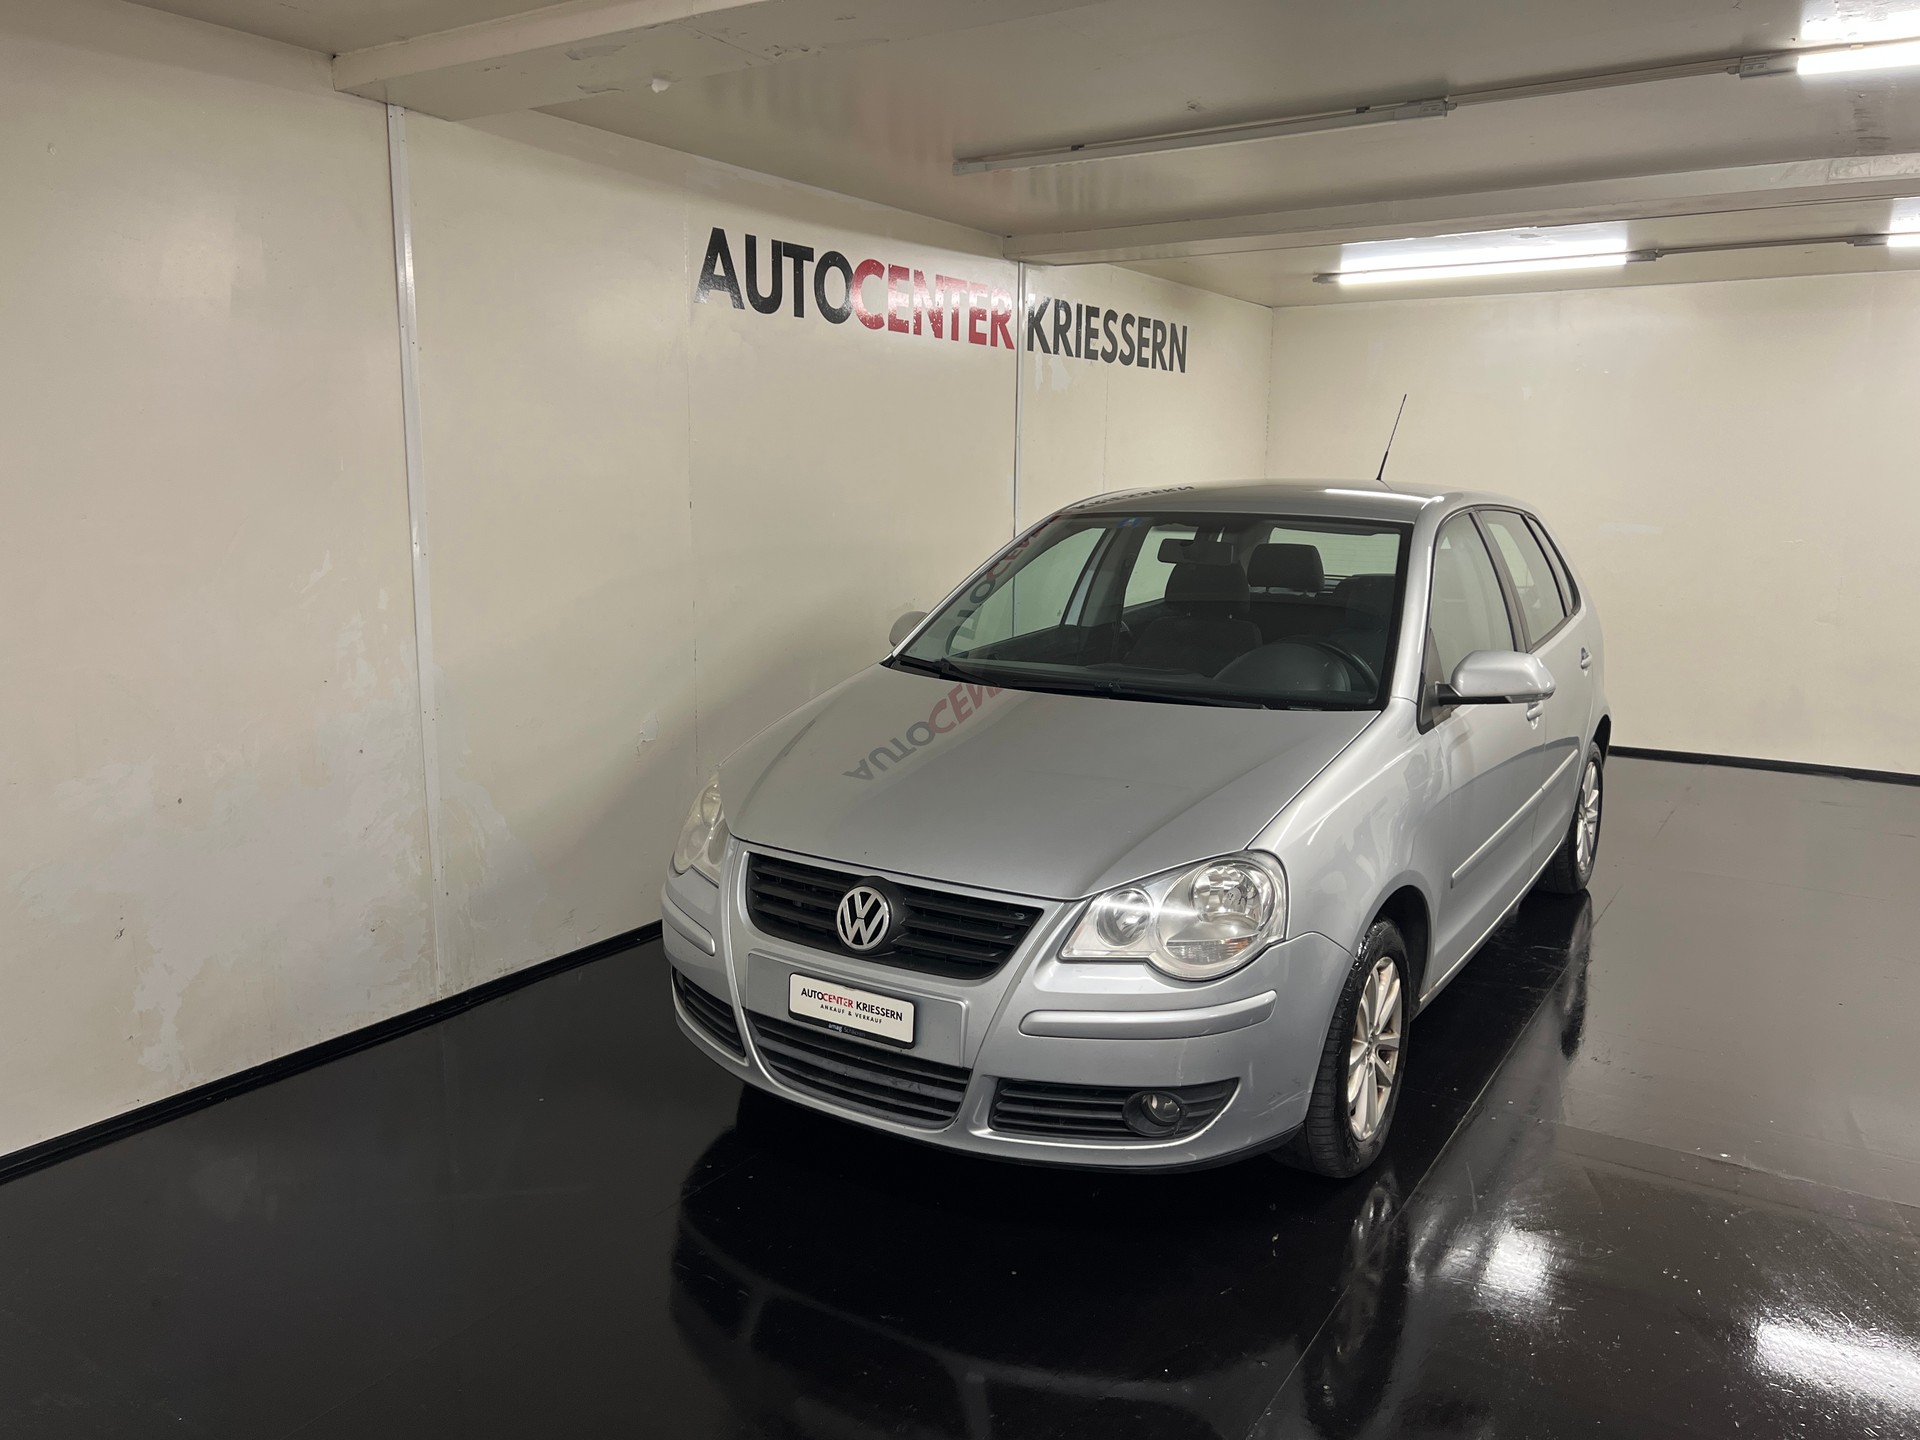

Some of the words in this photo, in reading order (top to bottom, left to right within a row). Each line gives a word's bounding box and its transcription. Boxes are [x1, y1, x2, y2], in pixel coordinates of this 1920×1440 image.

[694, 227, 1015, 351] AUTOCENTER
[1026, 294, 1188, 373] KRIESSERN
[837, 886, 889, 950] VW
[801, 987, 854, 1009] AUTOCENTER
[856, 1000, 903, 1022] KRIESSERN
[820, 1004, 845, 1015] ANKAUF
[855, 1013, 882, 1024] VERKAUF
